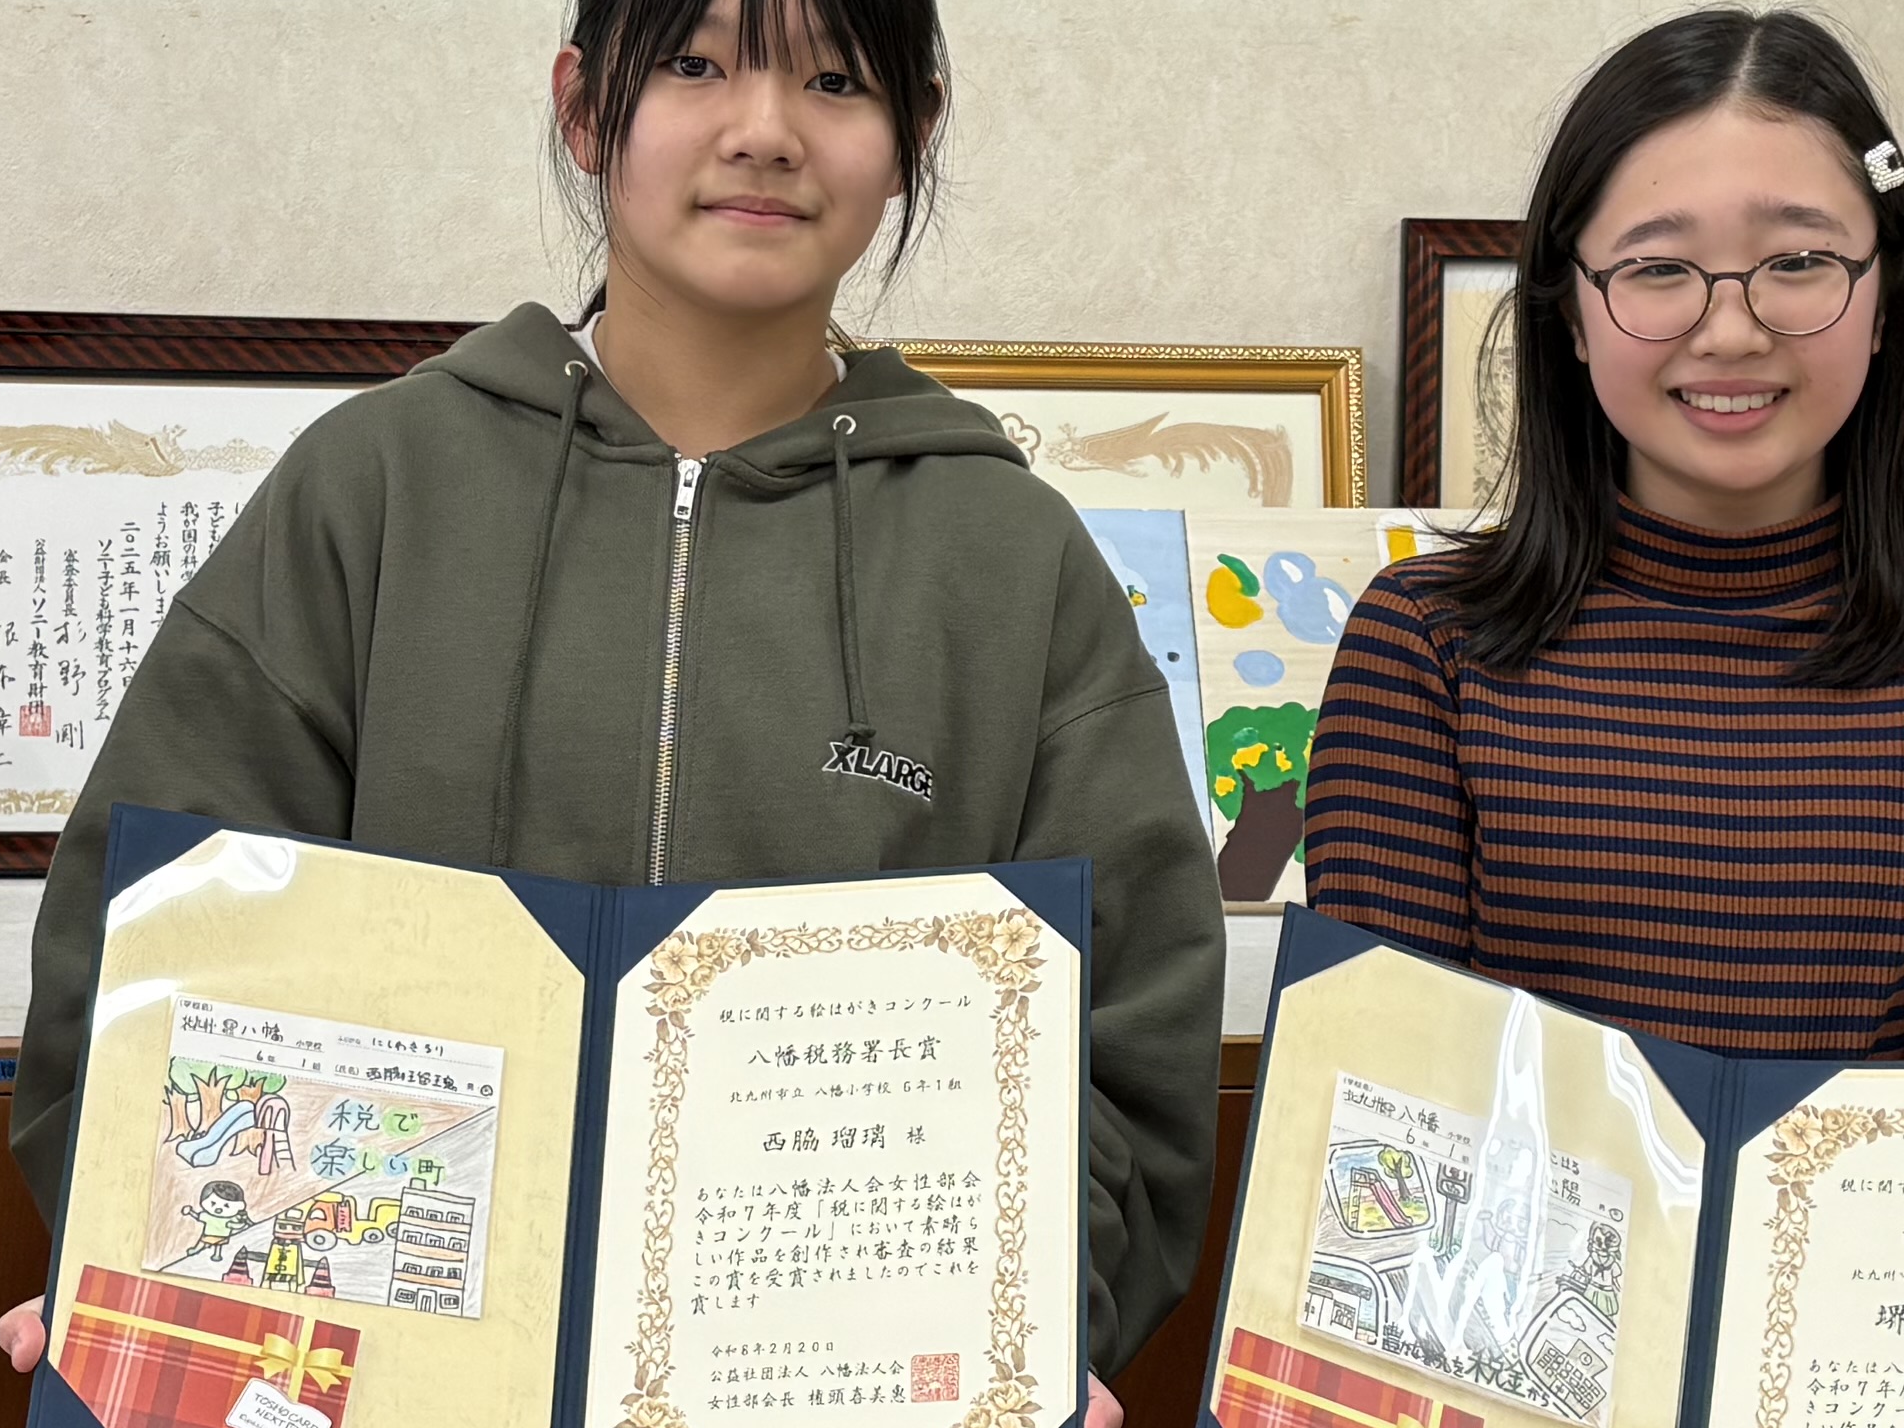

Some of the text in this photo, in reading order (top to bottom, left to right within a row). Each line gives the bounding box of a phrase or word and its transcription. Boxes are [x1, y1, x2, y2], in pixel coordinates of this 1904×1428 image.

[821, 740, 935, 801] XLARGE
[718, 996, 972, 1024] 税に関する絵はがきコンクール
[747, 1034, 942, 1069] 八幡税務署長賞
[729, 1086, 805, 1104] 北九州市立
[814, 1080, 892, 1100] 八幡小学校
[327, 1098, 418, 1134] 税で
[905, 1124, 927, 1145] 様
[310, 1137, 446, 1187] 楽しい町
[696, 1170, 982, 1203] あなたは八幡法人会女性部会
[690, 1293, 760, 1316] 賞します
[709, 1359, 905, 1384] 公益社団法人 八幡法人会
[707, 1390, 795, 1411] 女性部会長
